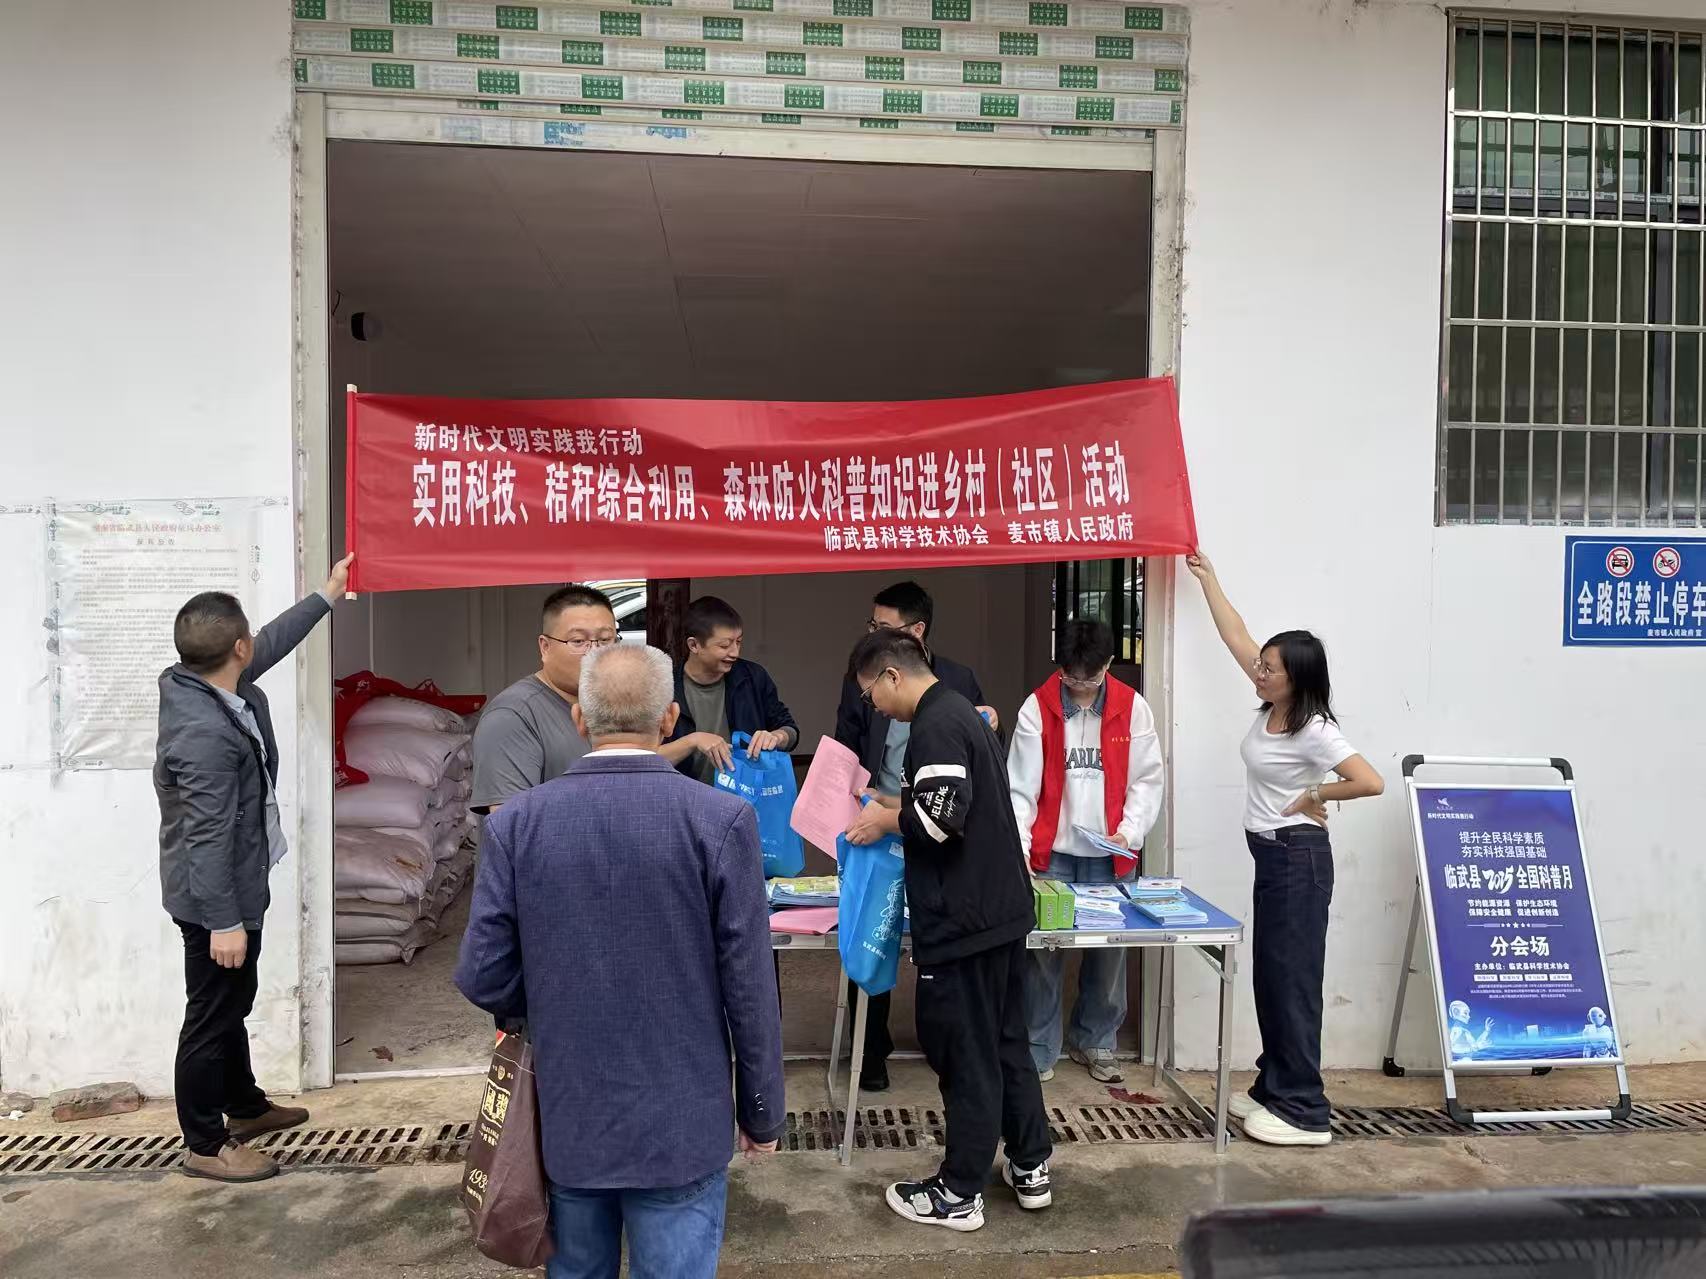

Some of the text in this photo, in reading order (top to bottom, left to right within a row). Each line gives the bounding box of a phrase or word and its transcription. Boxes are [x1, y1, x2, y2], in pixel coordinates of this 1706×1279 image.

[414, 422, 643, 456] 新时代文明实践我行动
[824, 513, 1135, 552] 临武县科学技术协会 麦市镇人民政府
[1577, 580, 1706, 626] 全路段禁止停车
[1459, 831, 1545, 845] 提升全民科学素质
[1461, 845, 1547, 859] 夯实科技强国基础
[1515, 899, 1558, 908] 保护生态环境
[1490, 935, 1550, 957] 分会场
